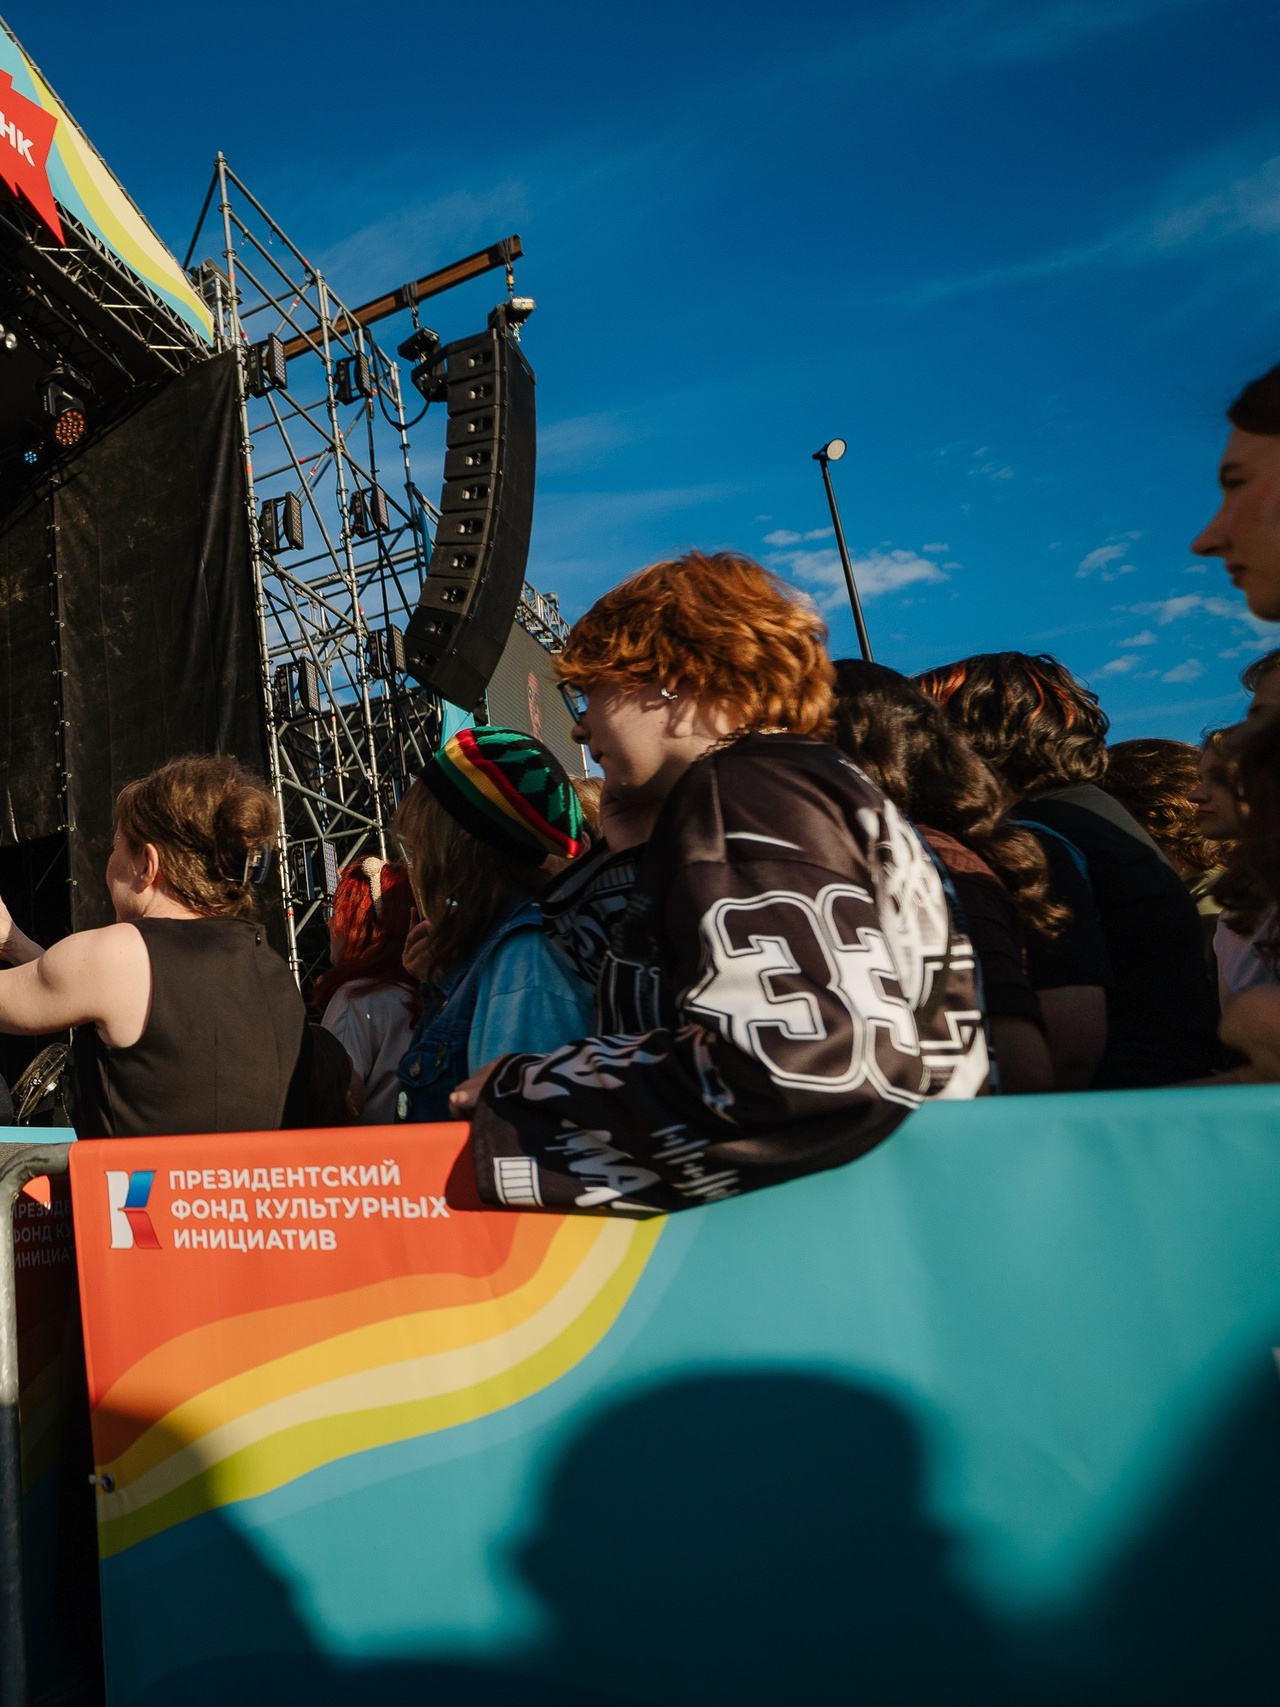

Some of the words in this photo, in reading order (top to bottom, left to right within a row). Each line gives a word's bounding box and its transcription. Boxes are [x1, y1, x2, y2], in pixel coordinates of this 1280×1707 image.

[169, 1159, 402, 1192] ПРЕЗИДЕНТСКИЙ
[170, 1198, 249, 1222] ФОНД
[255, 1196, 451, 1219] КУЛЬТУРНЫХ
[173, 1228, 338, 1253] ИНИЦИАТИВ
[15, 1246, 72, 1269] ИНИЦИА
